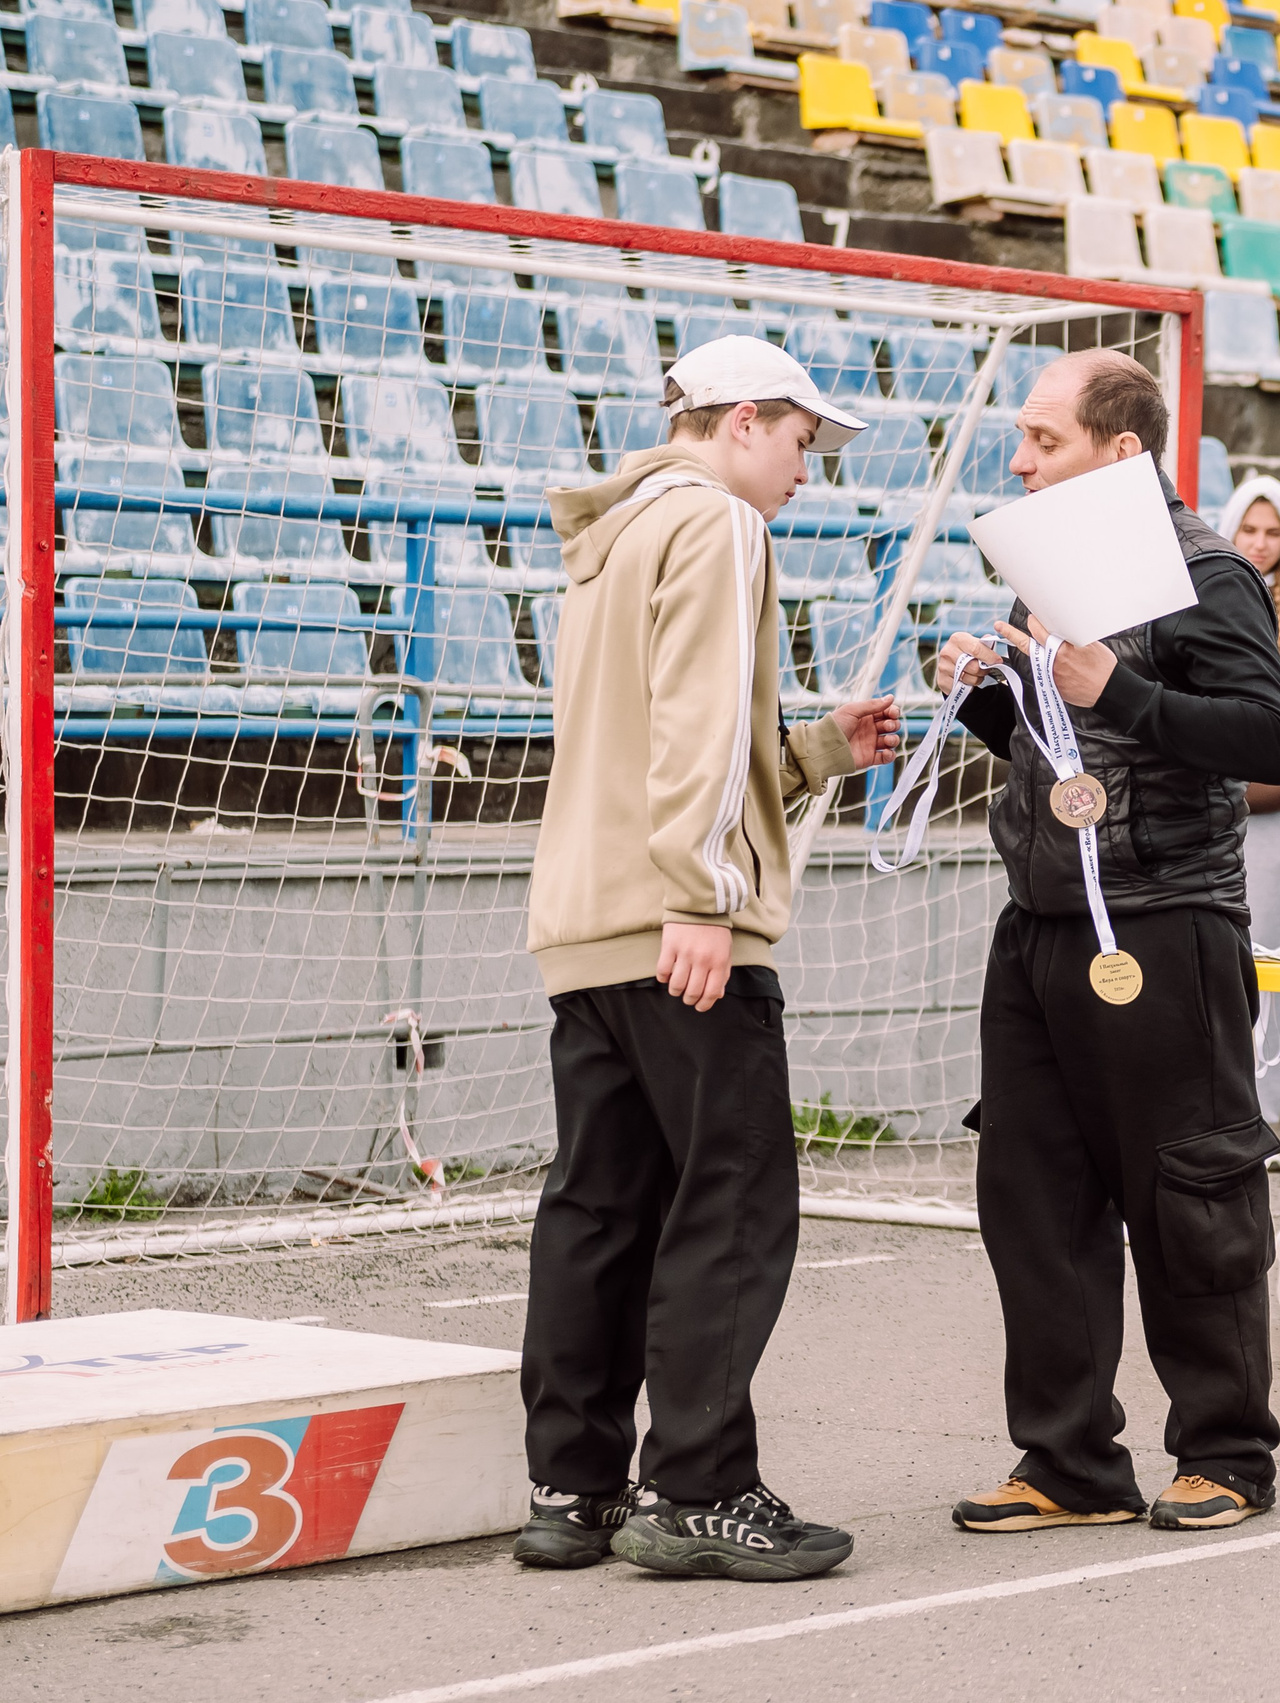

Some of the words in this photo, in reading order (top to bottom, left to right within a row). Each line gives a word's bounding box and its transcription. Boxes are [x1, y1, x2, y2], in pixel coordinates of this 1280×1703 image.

[1045, 710, 1062, 754] Пасхальный
[1051, 690, 1069, 732] Кемеровское
[1083, 815, 1096, 826] III
[112, 1353, 281, 1375] СТАДИОН
[163, 1429, 303, 1577] 3
